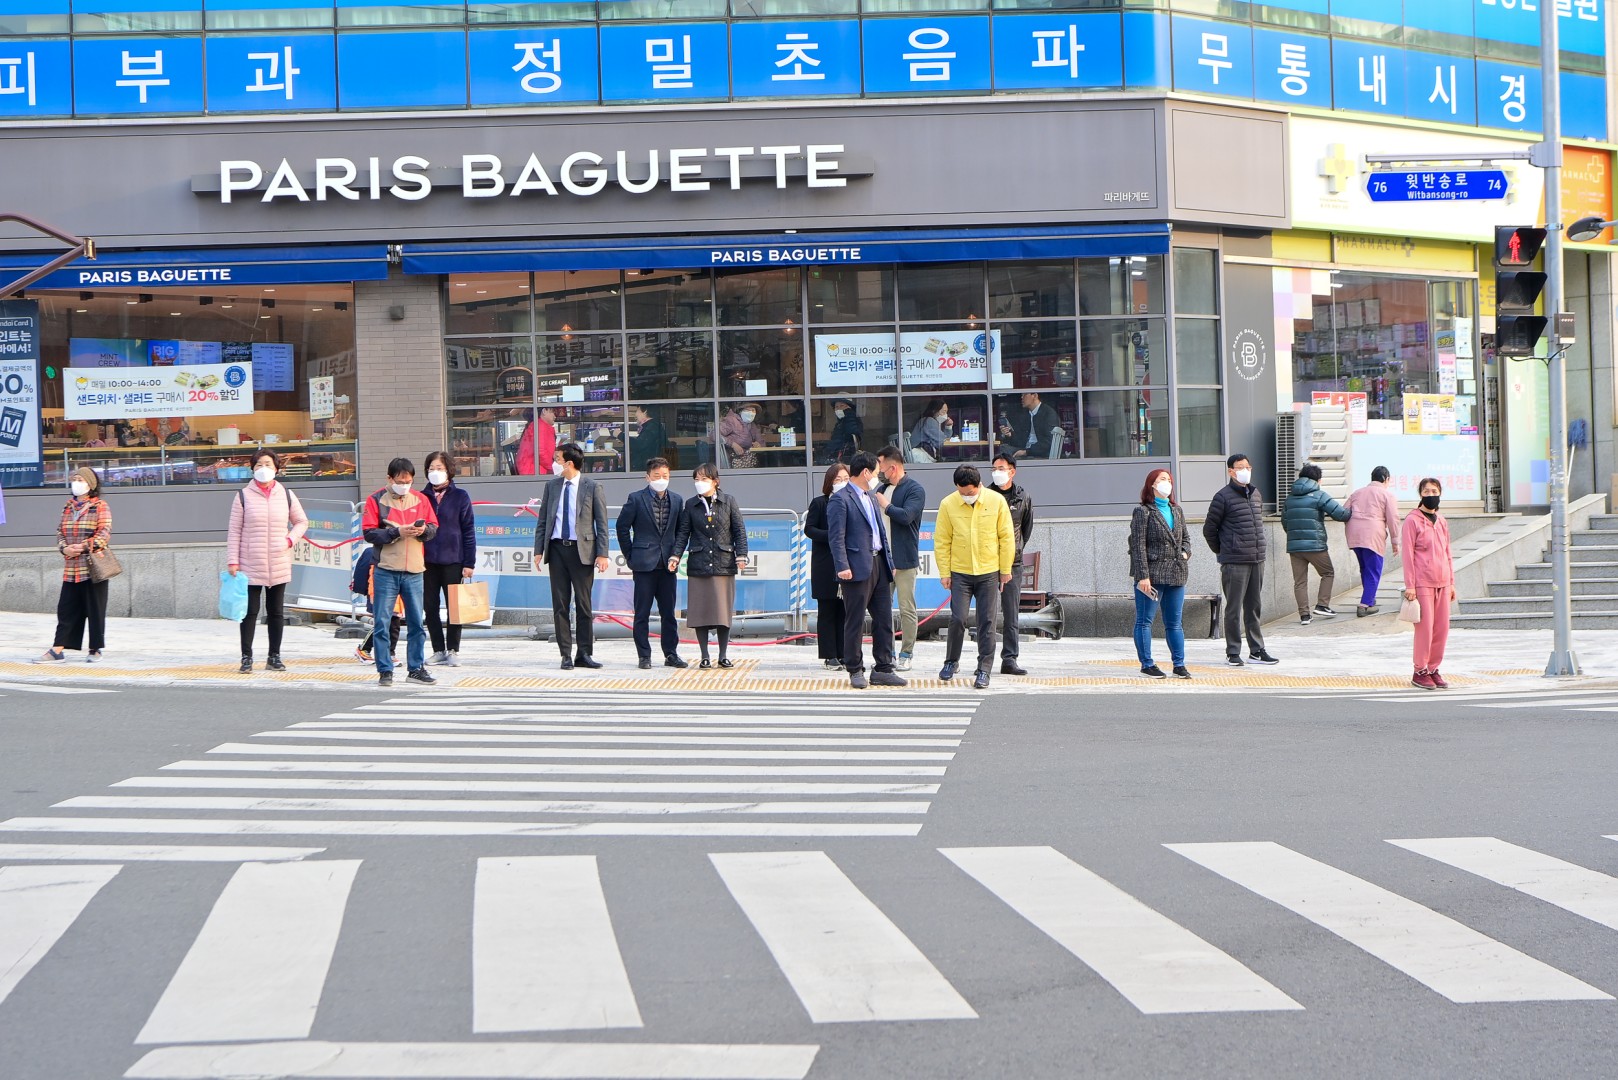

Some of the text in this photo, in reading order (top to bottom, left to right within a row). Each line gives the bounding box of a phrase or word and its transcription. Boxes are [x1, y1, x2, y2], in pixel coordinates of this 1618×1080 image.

[219, 143, 848, 203] PARIS BAGUETTE
[1373, 181, 1388, 193] 76
[1405, 172, 1468, 190] 윗반송로
[1487, 179, 1502, 191] 74
[1103, 191, 1150, 203] 파리바게뜨
[1407, 190, 1469, 200] Witbansong-ro
[711, 247, 861, 263] PARIS BAGUETTE
[79, 268, 231, 284] PARIS BAGUETTE
[100, 353, 119, 361] MINT
[153, 345, 175, 357] BIG
[906, 358, 935, 371] 구매시
[937, 356, 969, 369] 20%
[580, 374, 609, 383] BEVERAGE
[156, 391, 185, 403] 구매시
[188, 389, 219, 402] 20%
[219, 388, 240, 401] 할인
[483, 550, 532, 573] 제일
